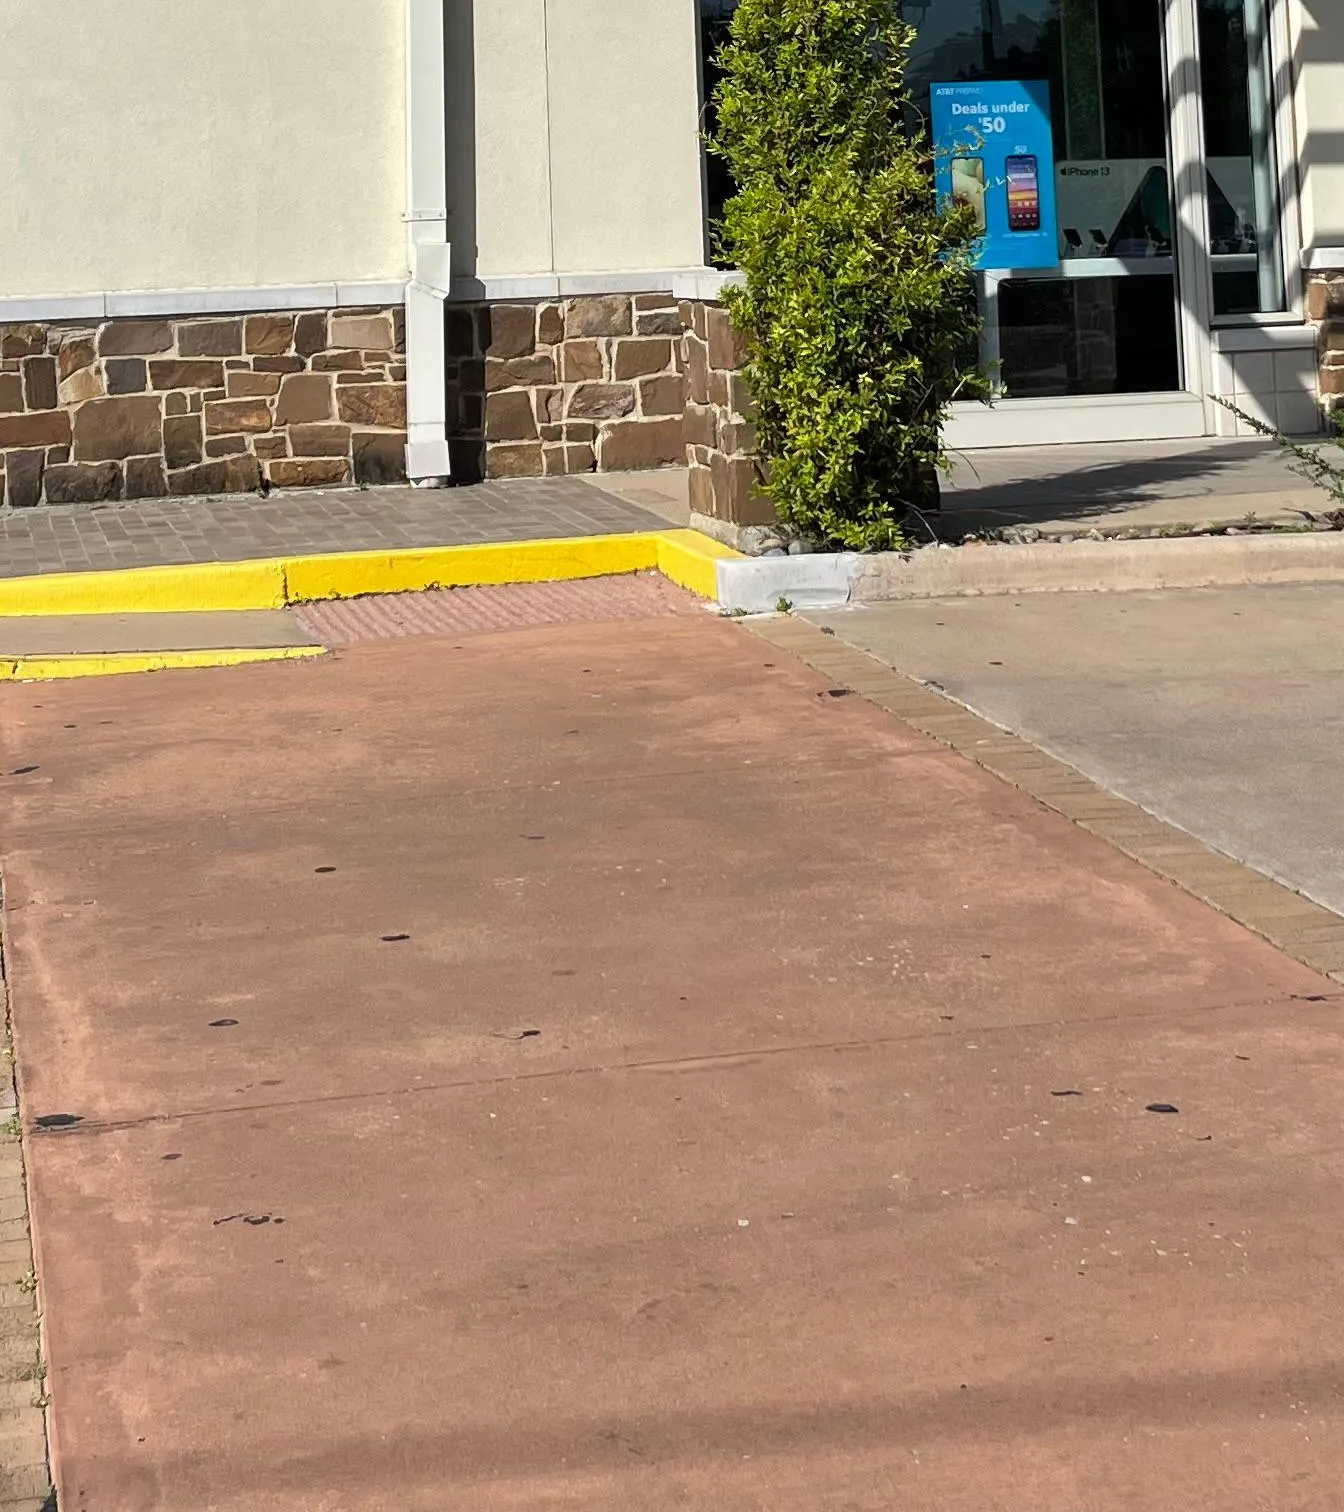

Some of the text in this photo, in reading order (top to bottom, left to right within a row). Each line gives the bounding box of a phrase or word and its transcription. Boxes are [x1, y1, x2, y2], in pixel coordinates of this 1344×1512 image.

[951, 101, 1030, 115] Deals under
[1068, 166, 1110, 177] iPhone 13
